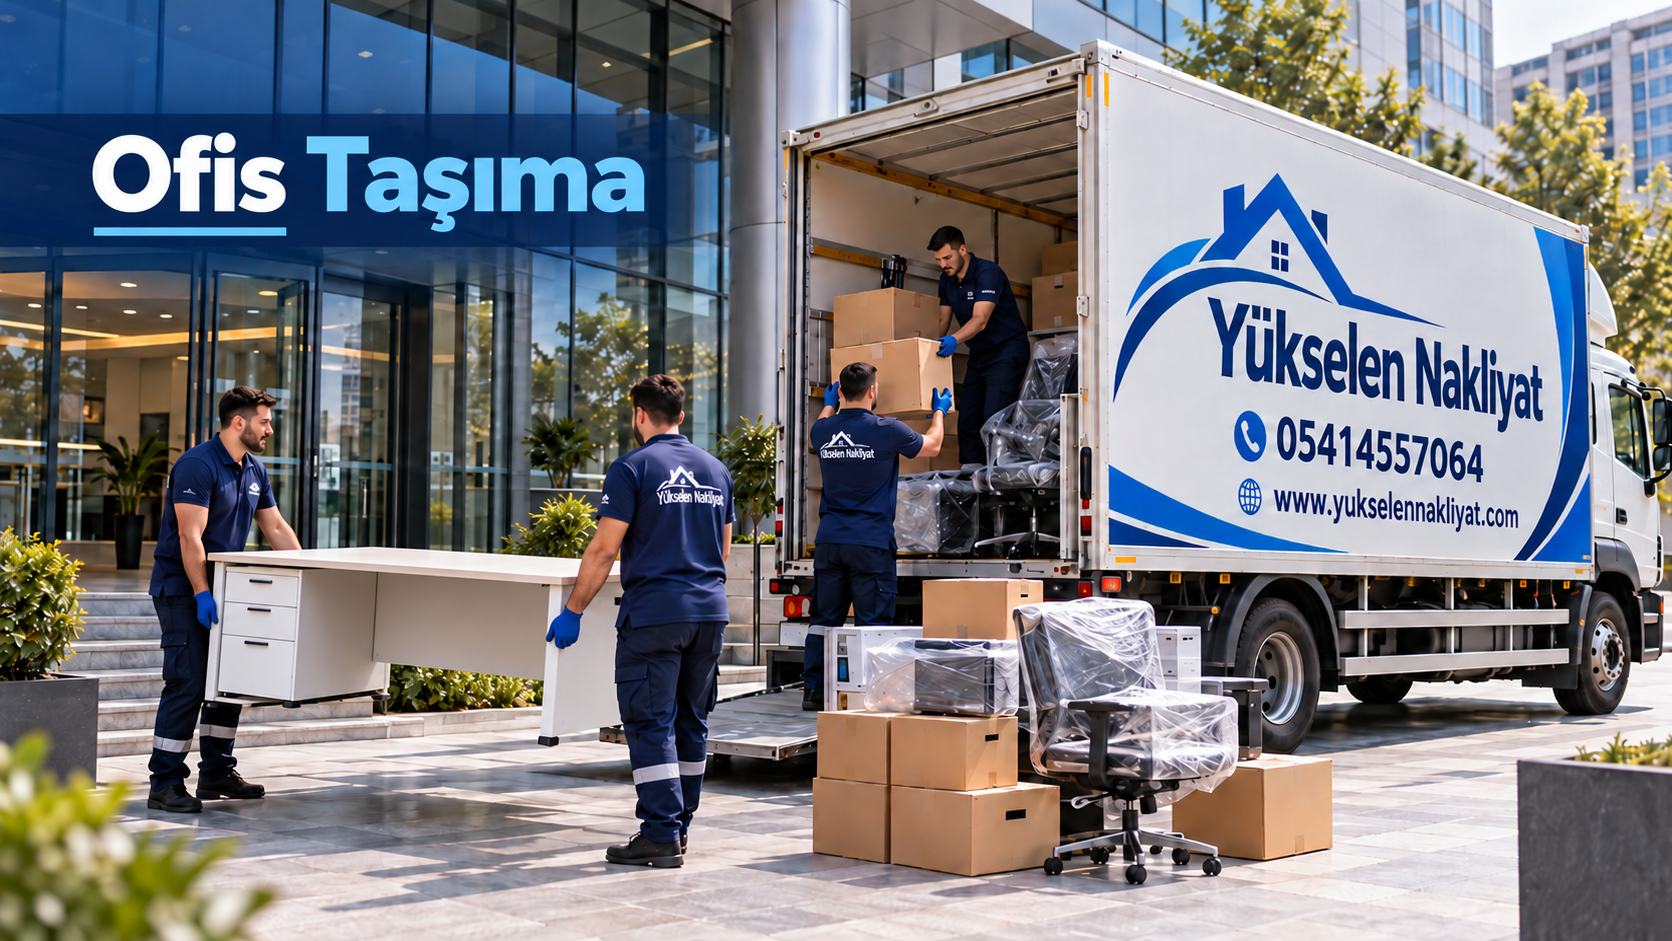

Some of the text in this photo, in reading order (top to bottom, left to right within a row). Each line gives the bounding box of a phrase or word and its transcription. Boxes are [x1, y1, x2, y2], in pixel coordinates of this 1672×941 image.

[1207, 296, 1544, 432] Yükselen Nakliyat
[1276, 416, 1484, 483] 05414557064
[1273, 488, 1519, 533] www.yukselennakliyat.com
